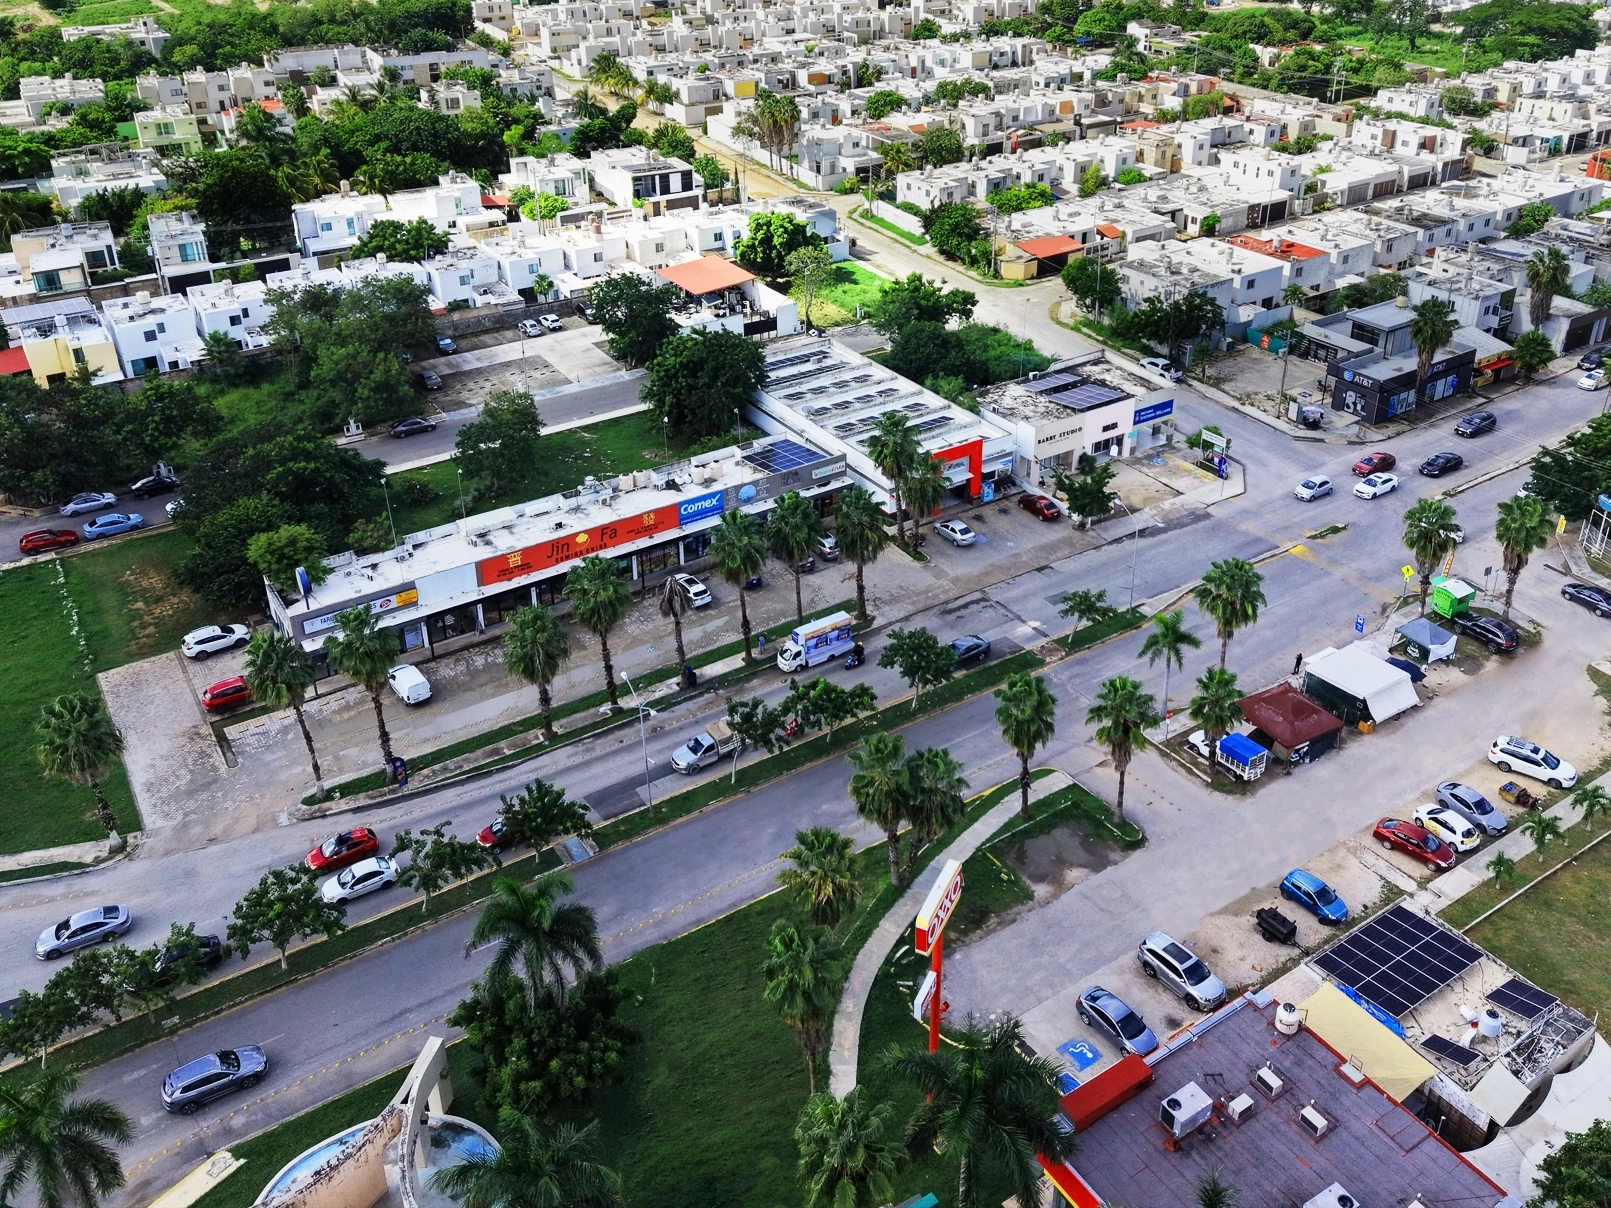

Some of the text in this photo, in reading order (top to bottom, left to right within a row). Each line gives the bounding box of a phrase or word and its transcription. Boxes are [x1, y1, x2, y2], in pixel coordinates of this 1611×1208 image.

[1432, 362, 1446, 374] AT&T
[1354, 375, 1374, 388] AT&T
[1058, 426, 1083, 438] STUDIO
[680, 493, 721, 515] Comex
[546, 541, 570, 559] Jin
[600, 526, 618, 542] Fa
[555, 543, 608, 563] COMIDA CHINA
[927, 875, 961, 945] OXXO
